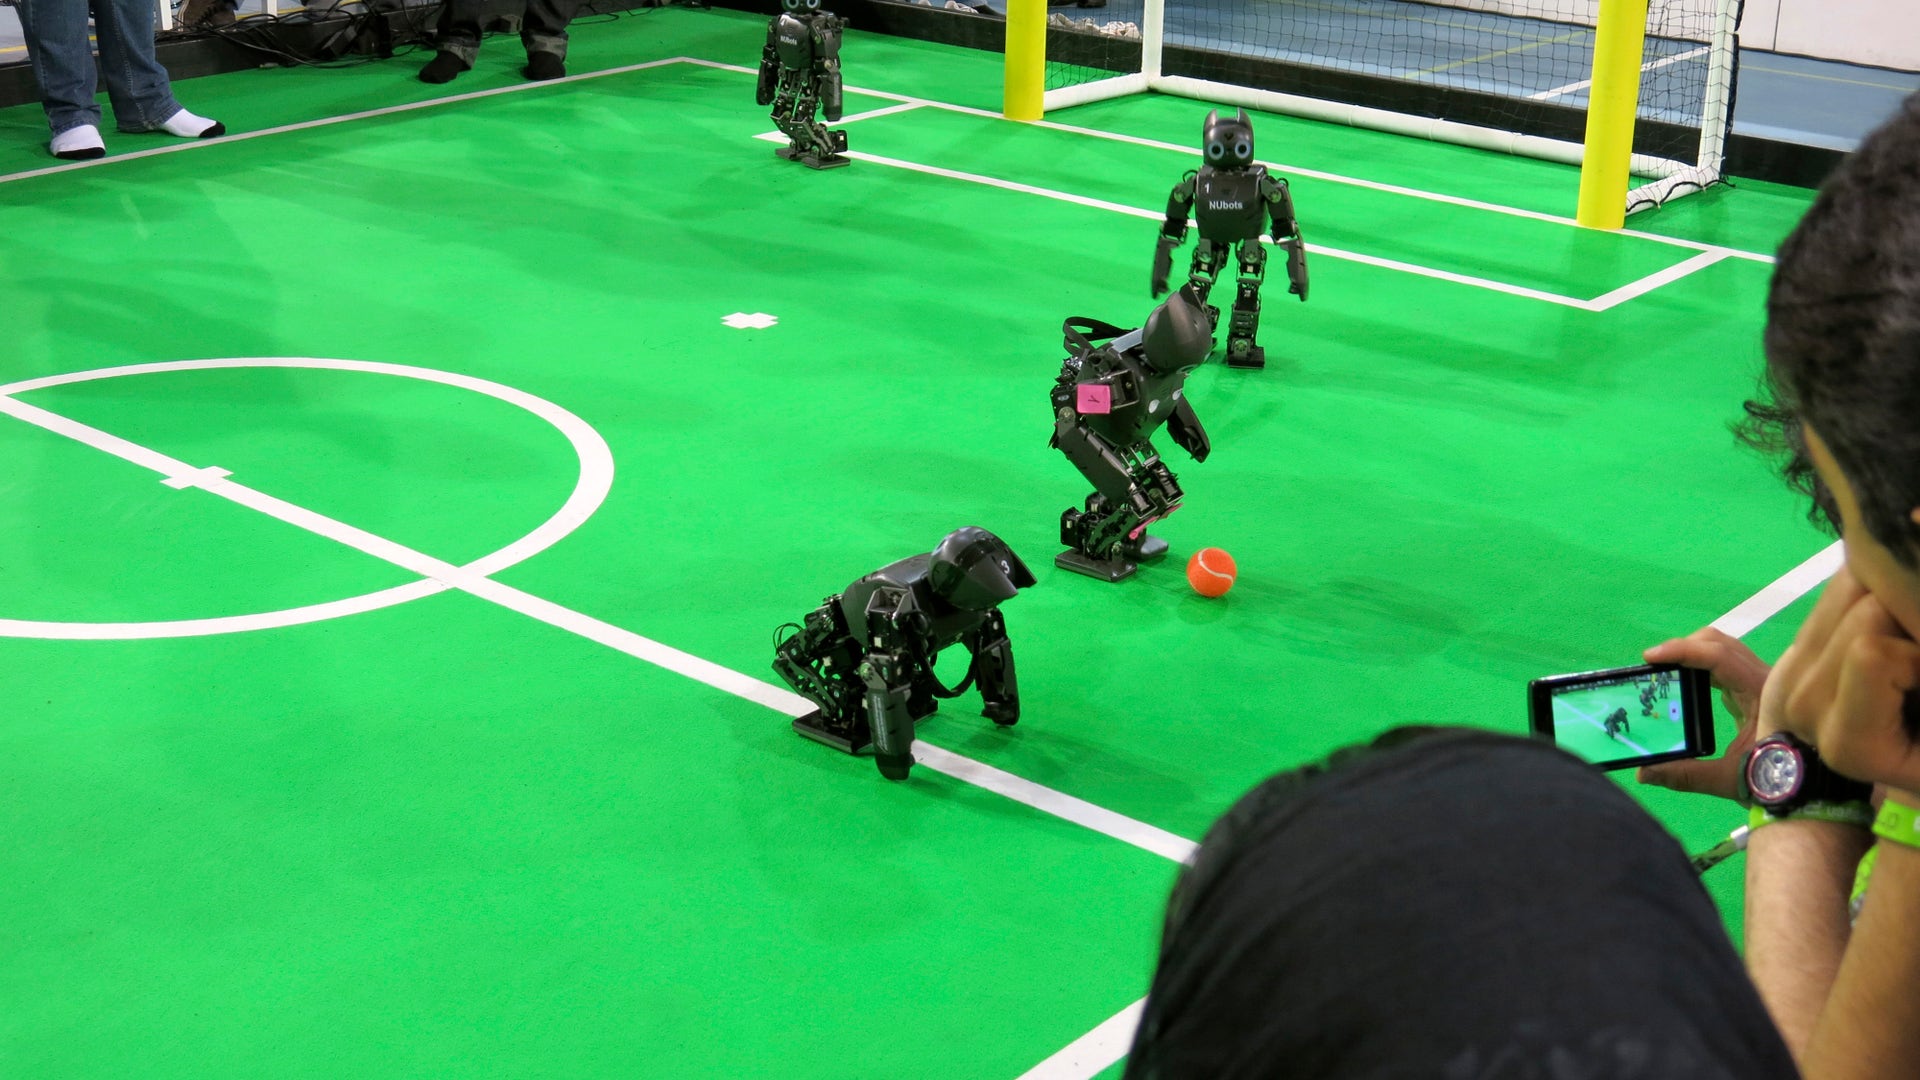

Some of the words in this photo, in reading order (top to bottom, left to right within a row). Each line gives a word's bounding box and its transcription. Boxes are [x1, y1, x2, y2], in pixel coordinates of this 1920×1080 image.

[1204, 183, 1210, 194] 1
[1209, 201, 1243, 210] NUbots
[1001, 560, 1010, 574] 3
